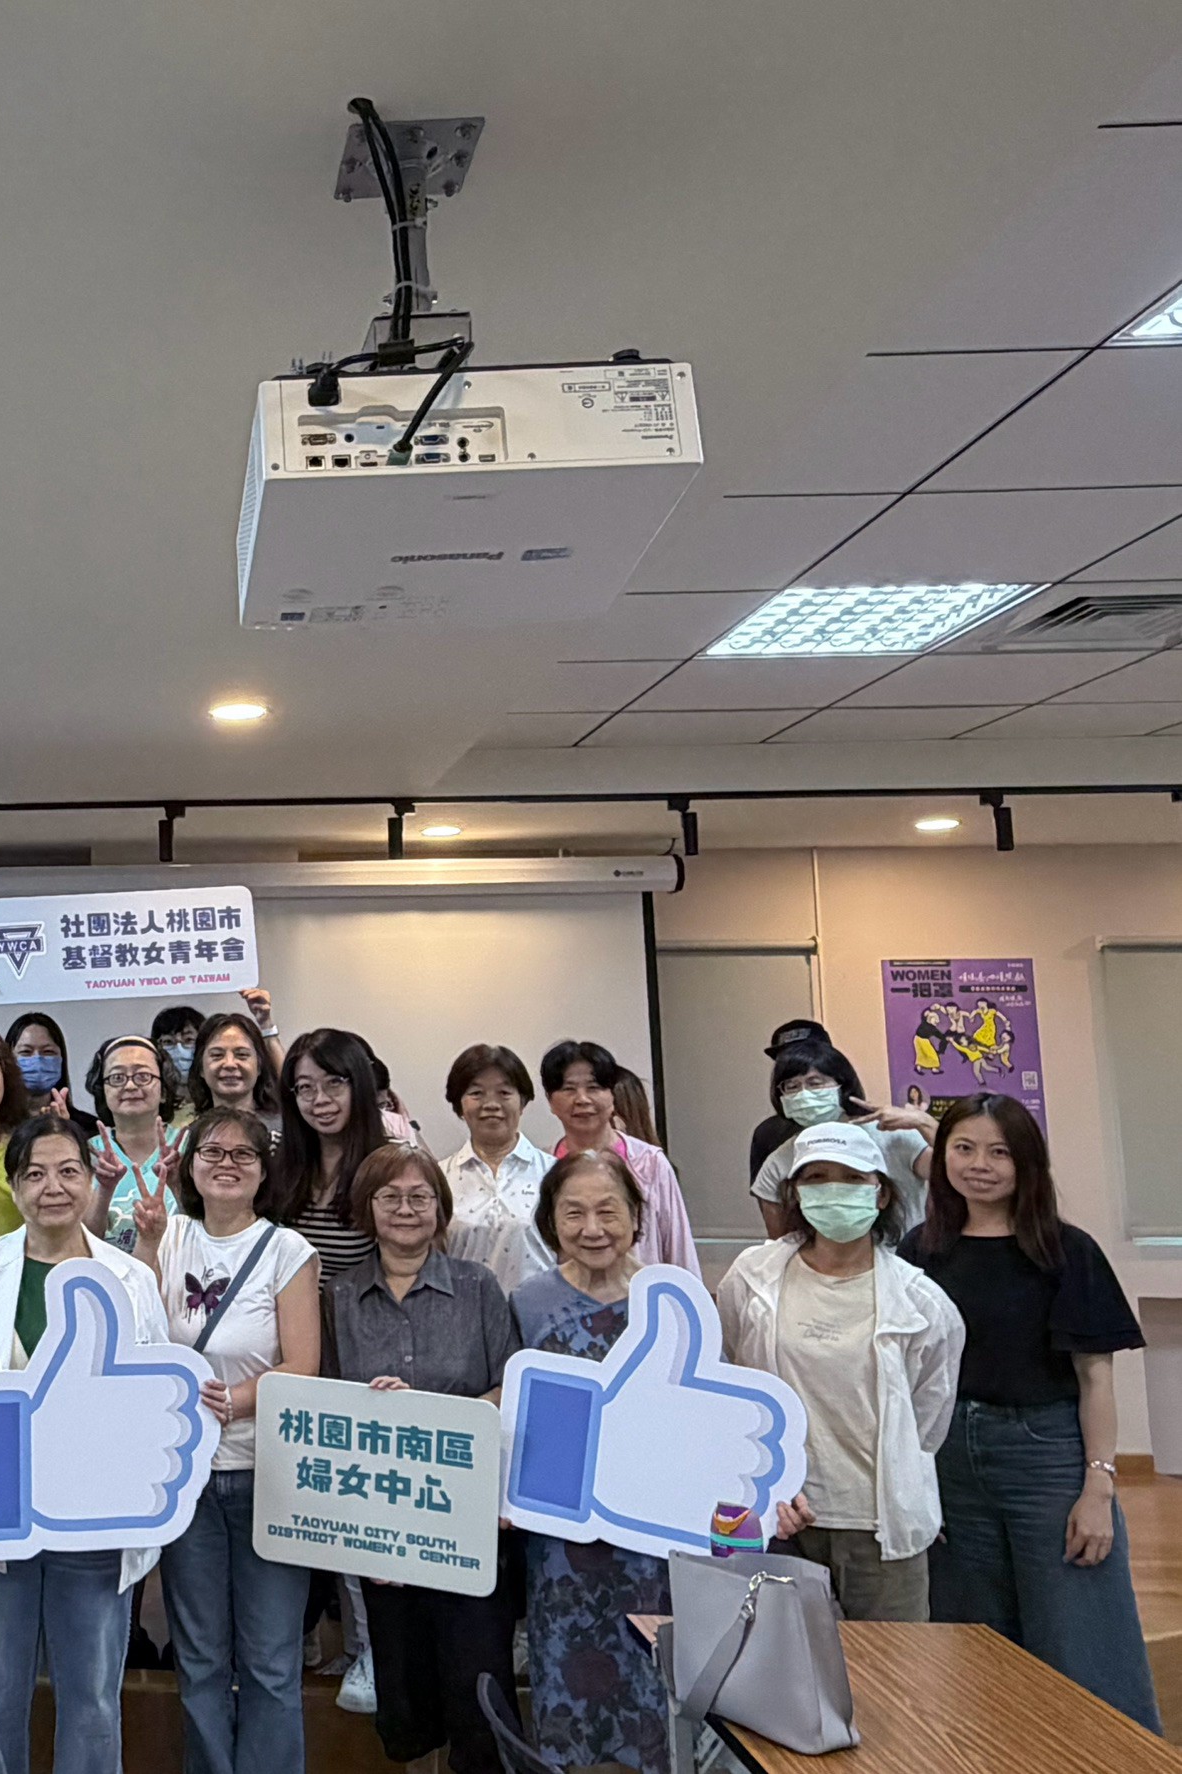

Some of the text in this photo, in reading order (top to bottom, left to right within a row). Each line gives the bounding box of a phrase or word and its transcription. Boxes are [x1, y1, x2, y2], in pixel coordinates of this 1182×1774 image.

[390, 551, 505, 565] Panasonic
[60, 906, 242, 939] 社團法人桃園市
[62, 937, 246, 970] 基督教女青年會
[85, 973, 231, 989] TAOYUAN YWCA OF TAIWAN
[890, 970, 952, 982] WOMEN
[279, 1408, 475, 1469] 桃園市南區
[296, 1456, 452, 1514] 婦女中心
[267, 1524, 338, 1546] DISTRICT
[419, 1551, 480, 1570] CENTER
[291, 1514, 457, 1552] TAOYUAN CITY SOUTH
